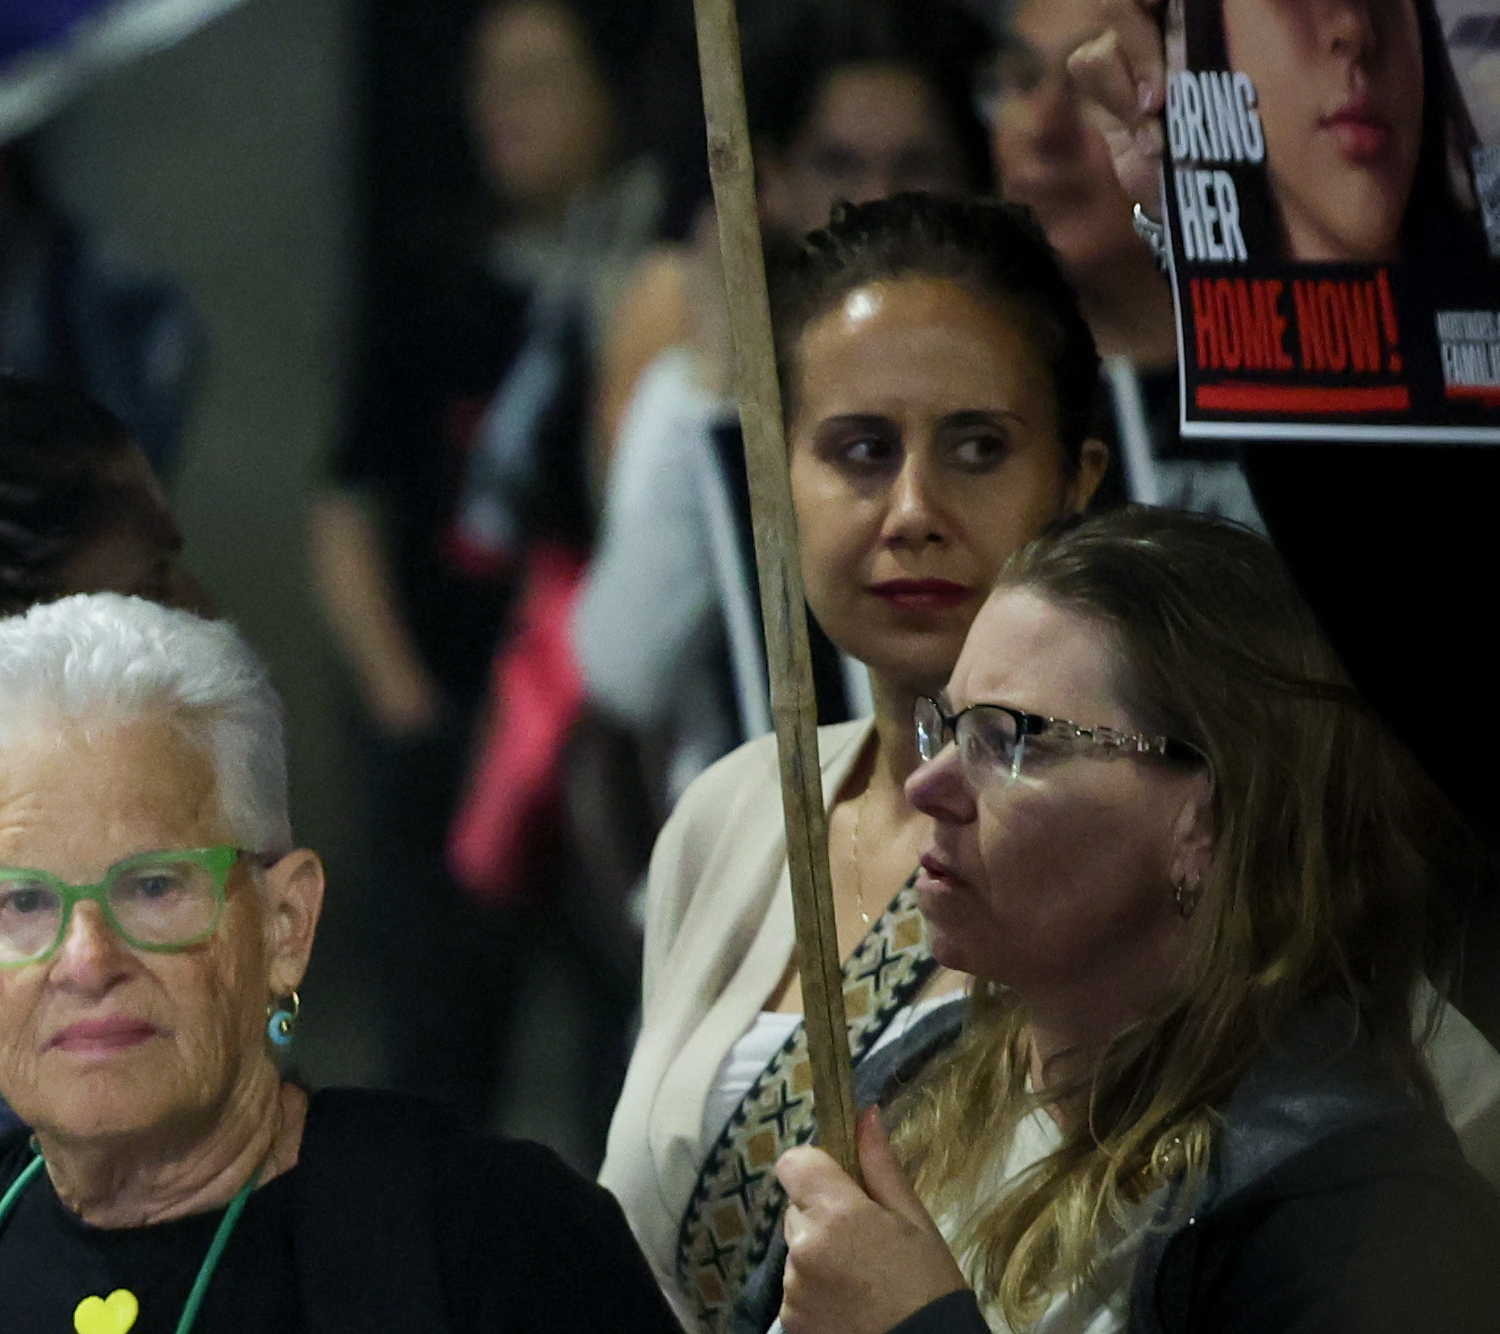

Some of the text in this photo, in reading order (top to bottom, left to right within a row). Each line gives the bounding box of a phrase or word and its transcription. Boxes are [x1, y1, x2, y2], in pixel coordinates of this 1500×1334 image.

[1165, 70, 1265, 162] BRING
[1174, 169, 1248, 262] HER
[1191, 278, 1293, 370] HOME
[1293, 268, 1404, 374] NOW!
